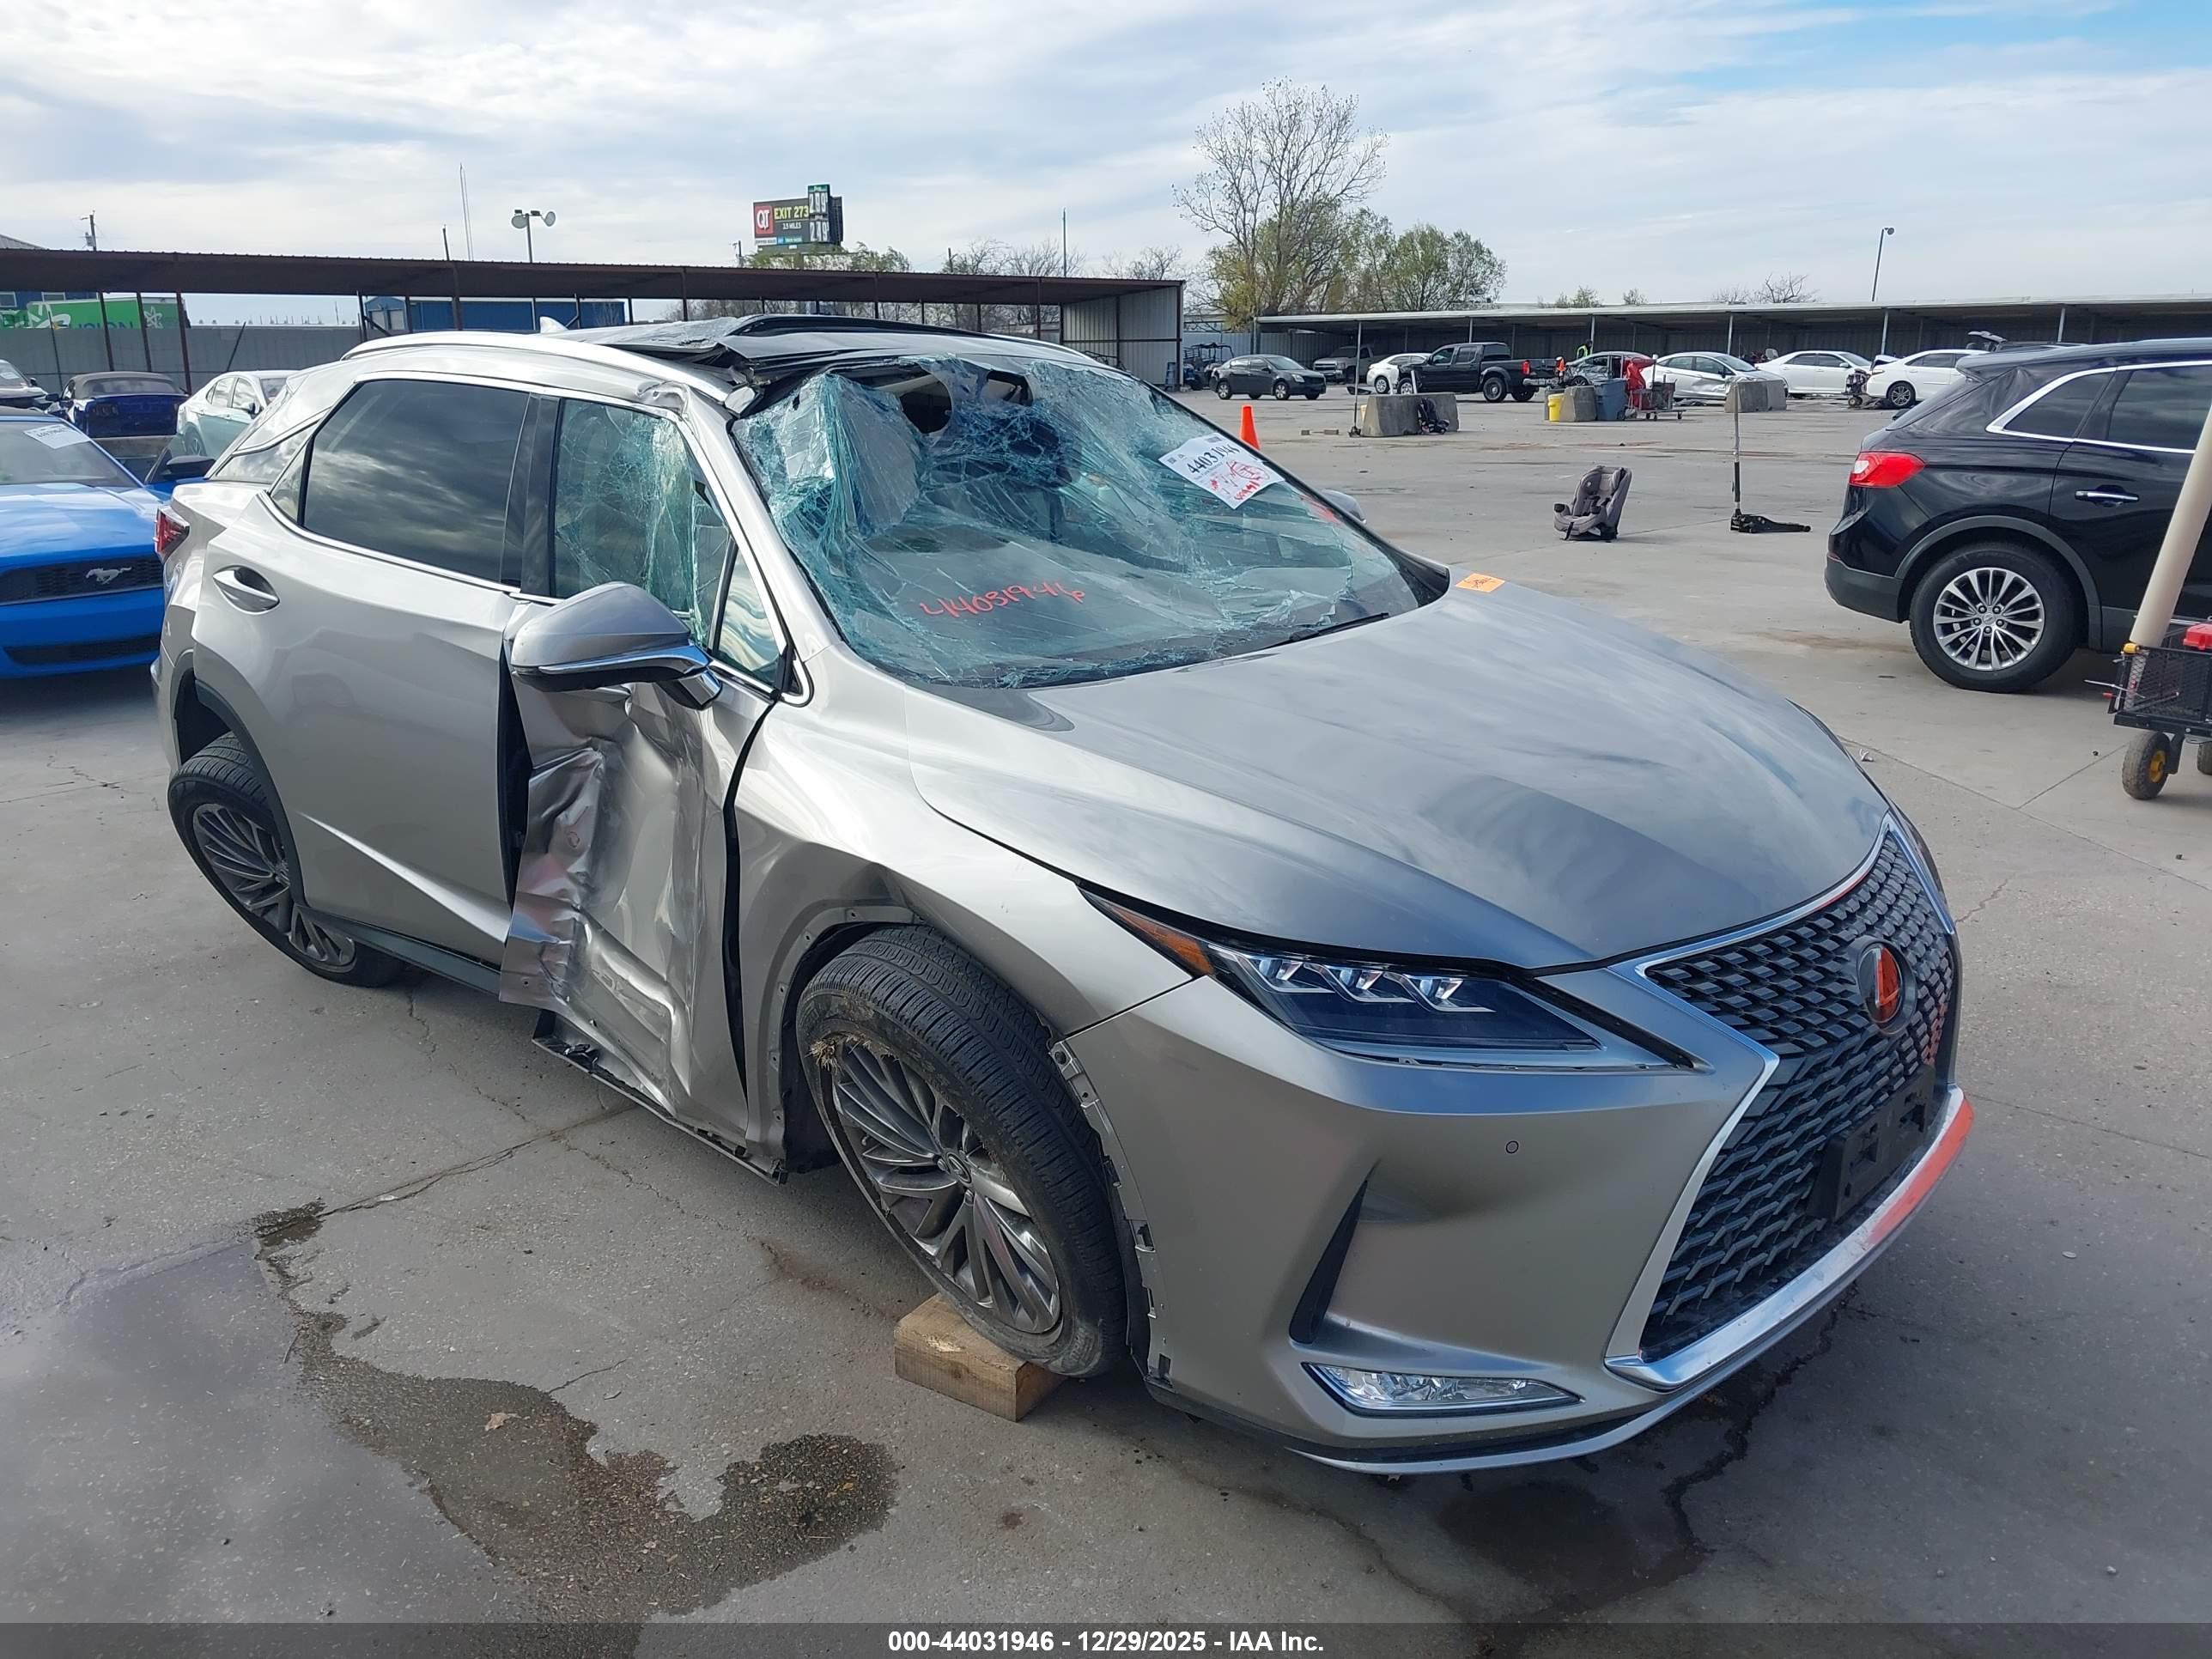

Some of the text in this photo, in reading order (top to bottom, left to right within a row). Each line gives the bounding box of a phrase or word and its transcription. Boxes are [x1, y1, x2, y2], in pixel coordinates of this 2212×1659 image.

[757, 209, 770, 231] QT
[774, 205, 809, 220] EXIT 273
